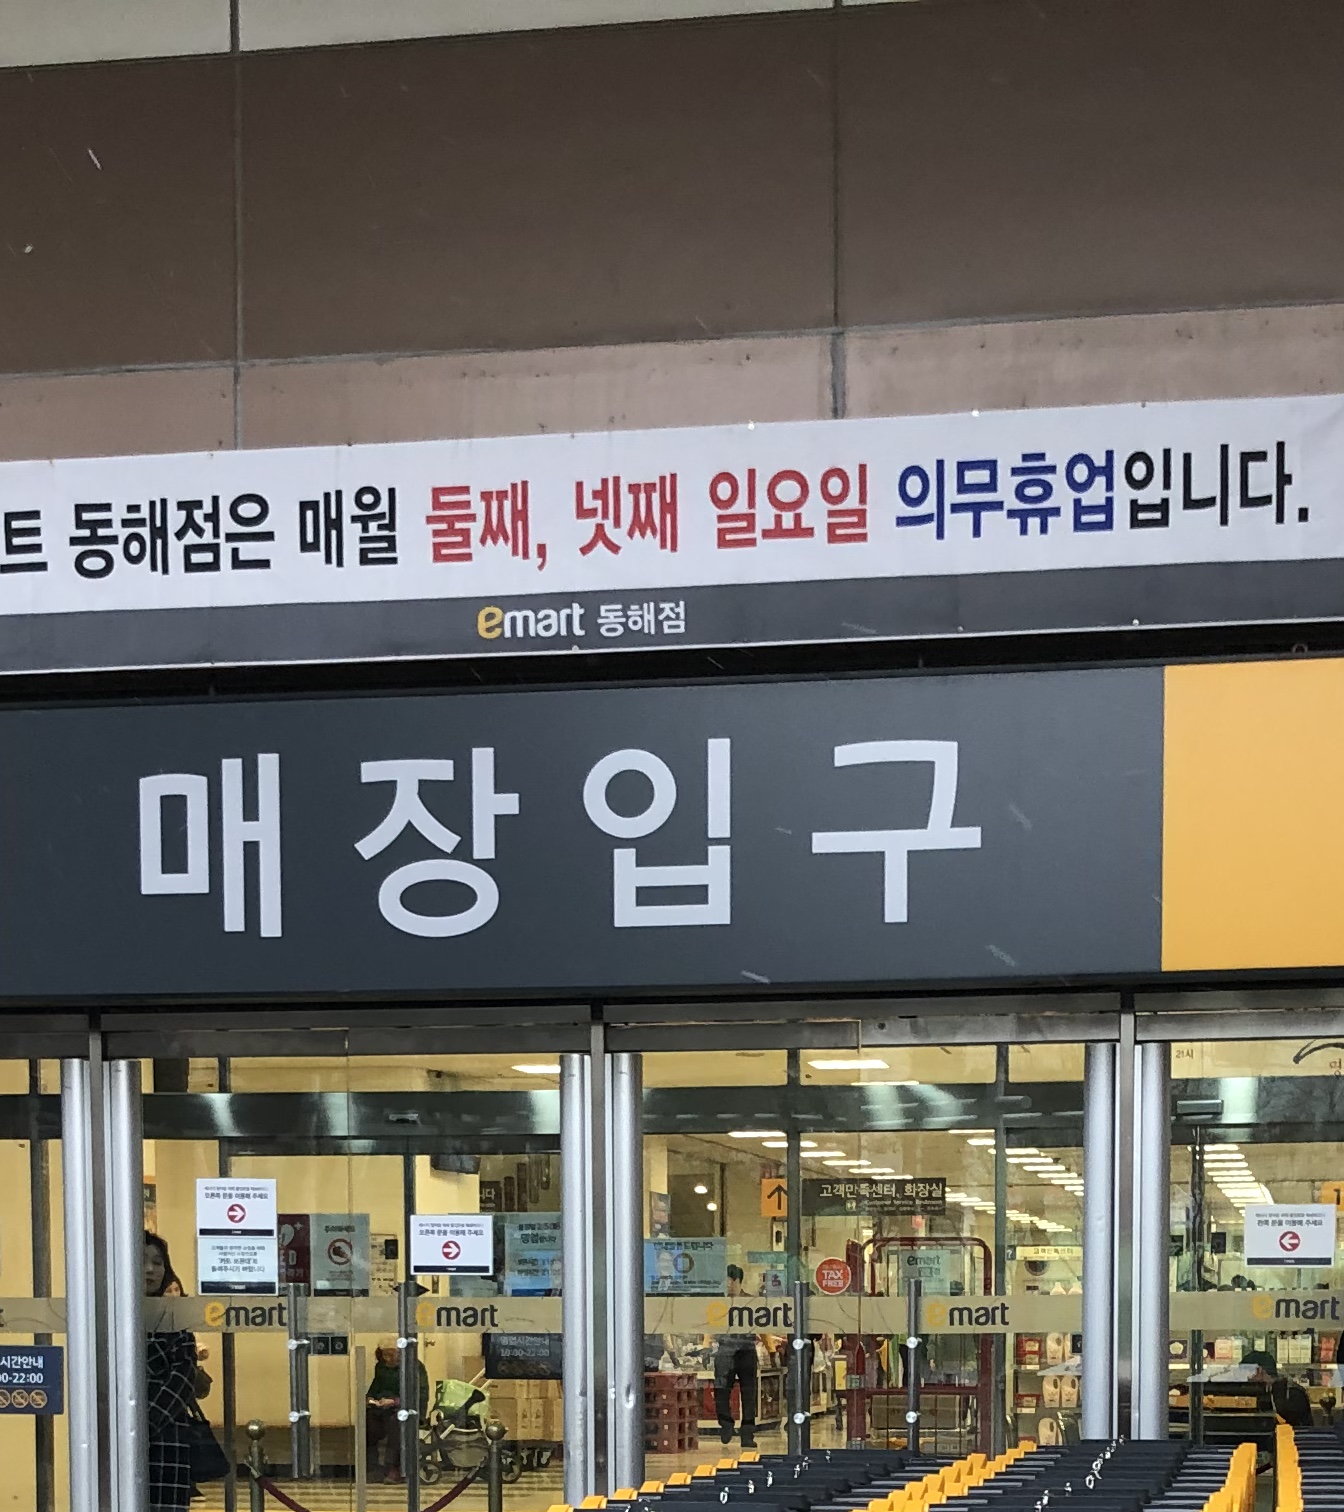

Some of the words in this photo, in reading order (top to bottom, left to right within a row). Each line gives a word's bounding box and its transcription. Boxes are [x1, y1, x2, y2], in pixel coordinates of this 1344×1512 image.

[68, 491, 276, 580] 동해점은
[298, 485, 399, 569] 매월
[425, 479, 548, 571] 둘째,
[573, 471, 679, 556] 넷째
[709, 463, 871, 551] 일요일
[895, 440, 1311, 541] 의무휴업입니다.
[477, 602, 586, 640] emart
[597, 600, 688, 638] 동해점
[904, 1182, 943, 1198] 화장실
[822, 1269, 844, 1280] TAX
[822, 1279, 844, 1288] FREE
[205, 1302, 287, 1328] emart
[416, 1301, 499, 1328] emart
[707, 1302, 794, 1328] emart
[926, 1302, 1010, 1328] emart
[1252, 1293, 1341, 1321] emart
